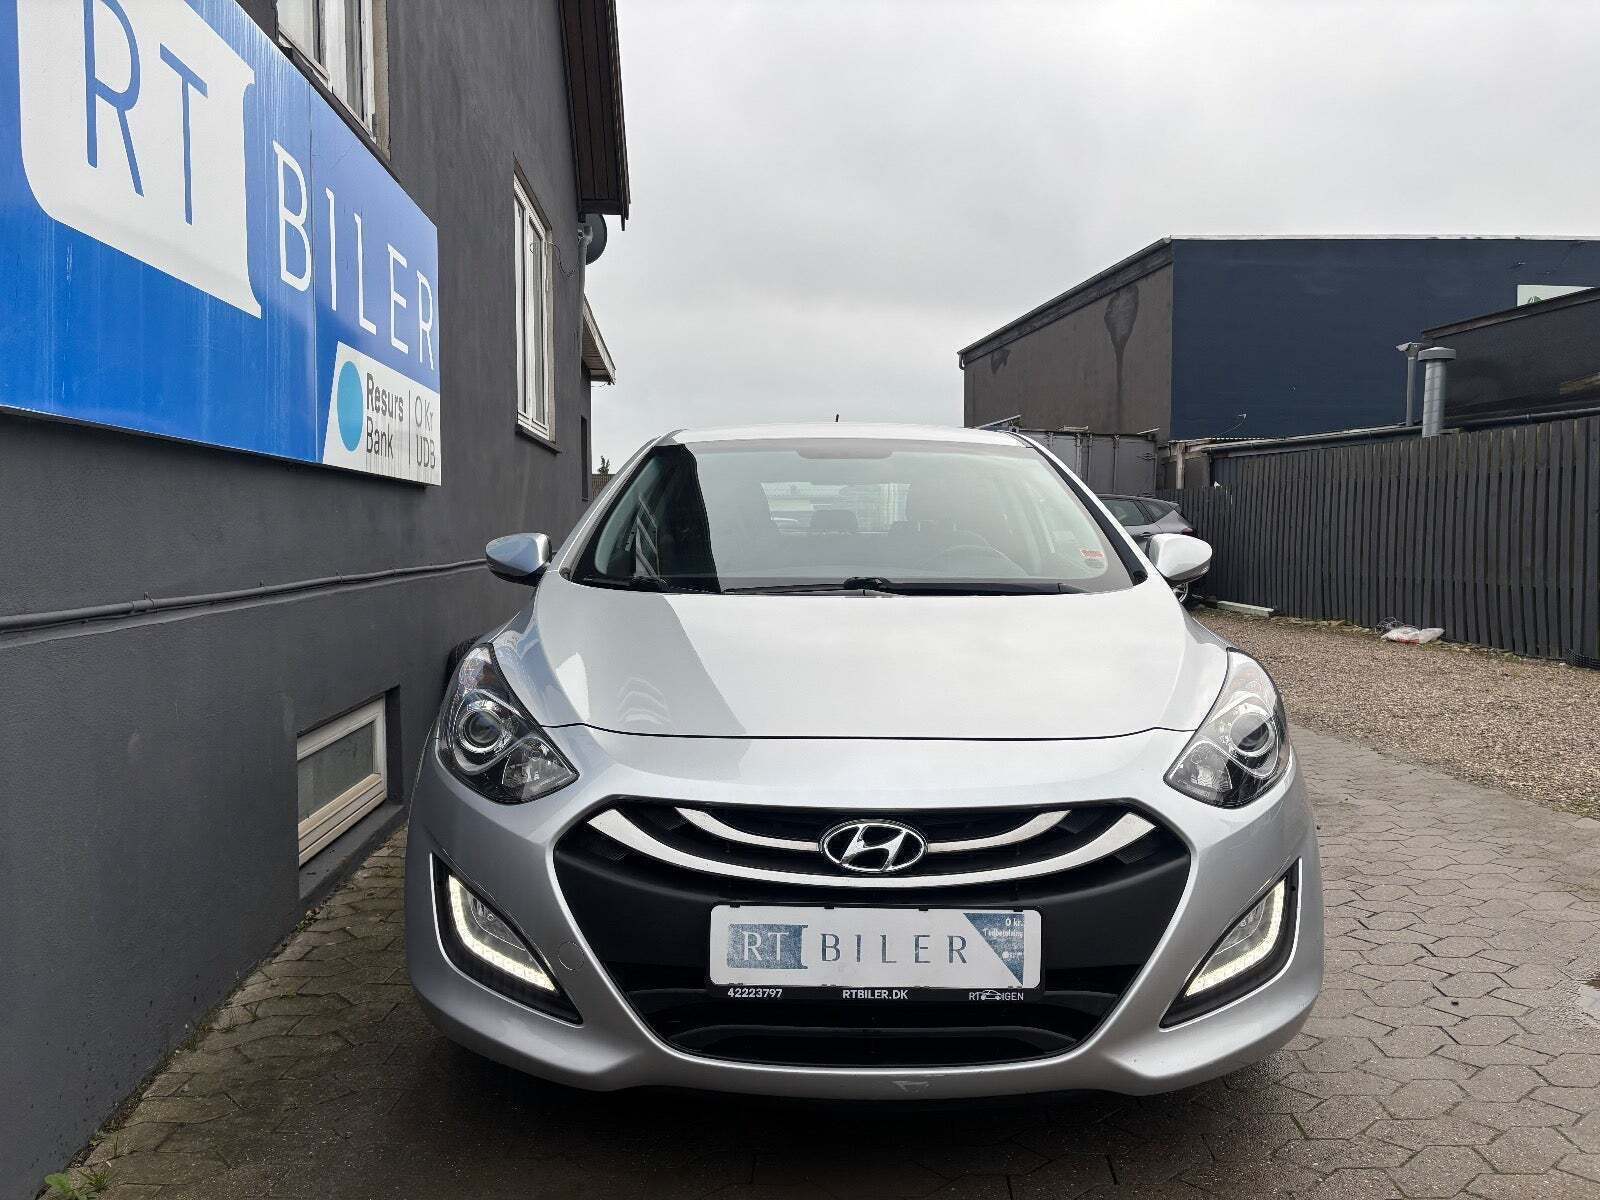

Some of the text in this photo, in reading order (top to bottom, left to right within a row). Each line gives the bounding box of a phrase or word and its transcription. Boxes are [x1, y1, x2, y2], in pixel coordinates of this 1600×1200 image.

[83, 0, 435, 371] RT BILER
[366, 372, 404, 422] Resurs
[366, 415, 394, 460] Bank
[742, 931, 968, 964] RT BILER
[727, 988, 783, 998] 42223797
[842, 989, 908, 1000] RTBILER.DK
